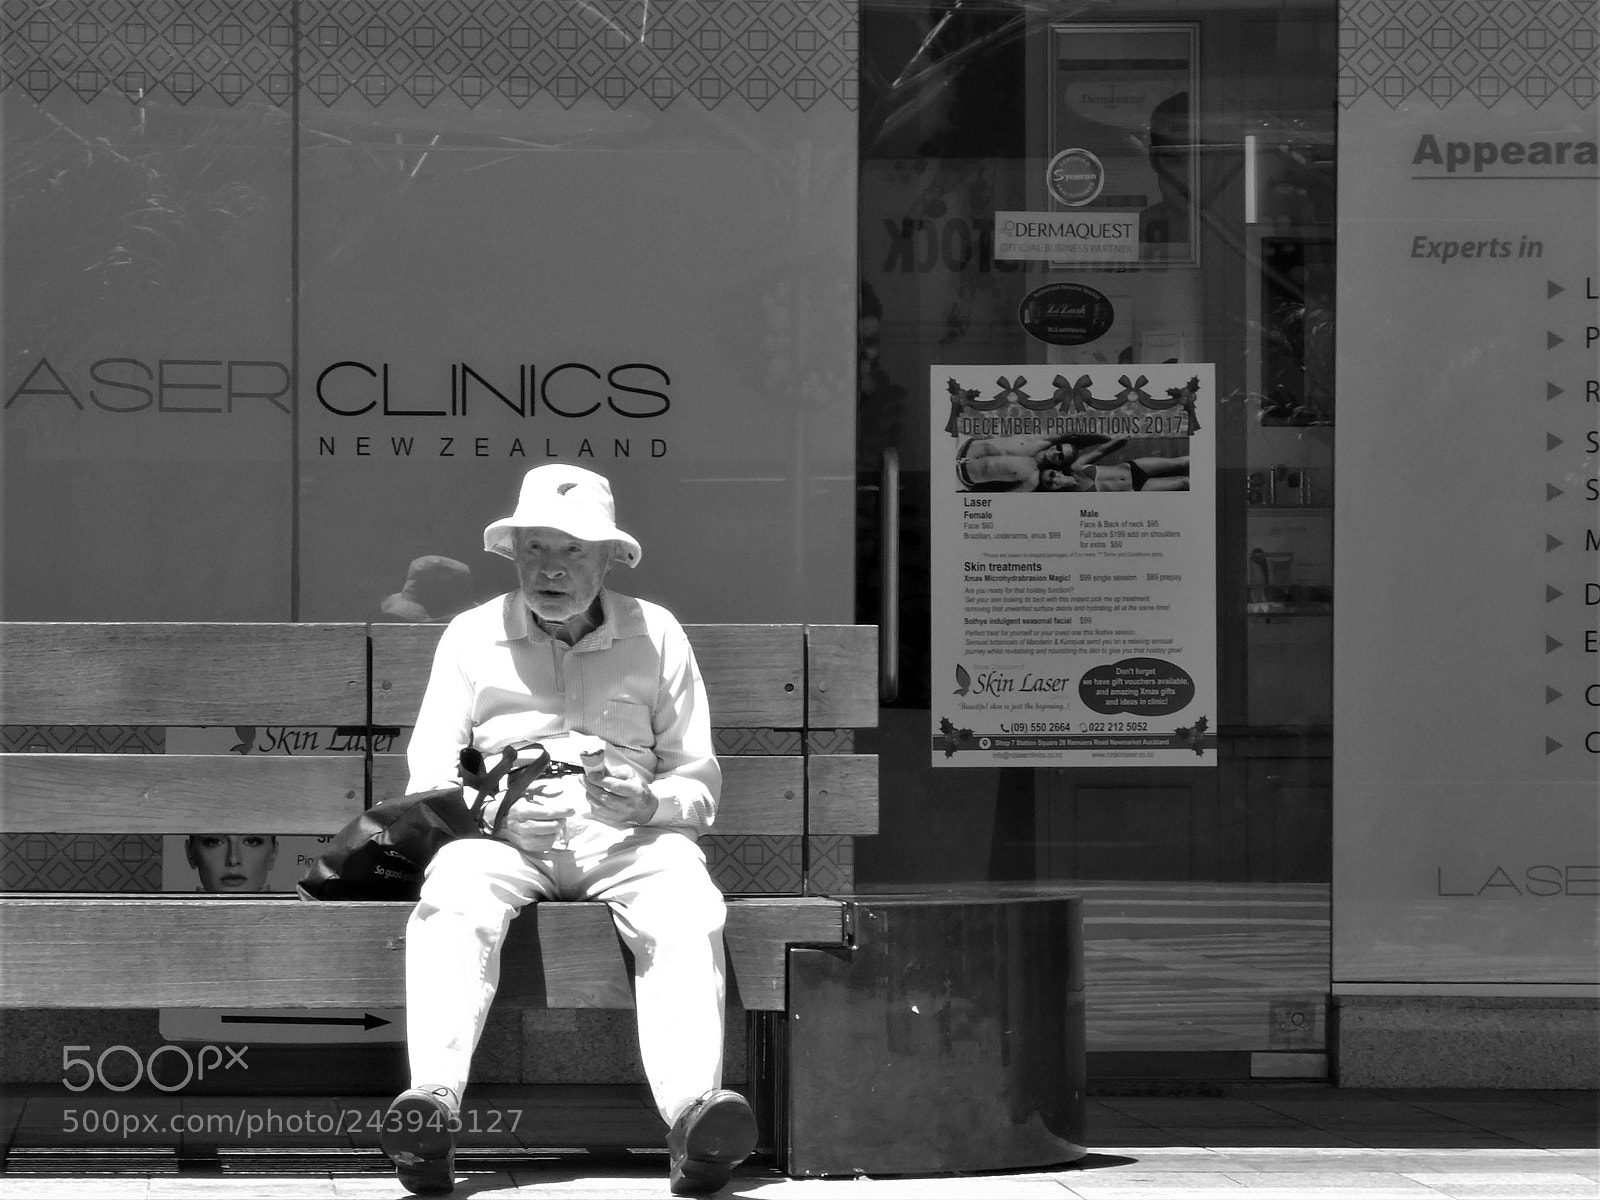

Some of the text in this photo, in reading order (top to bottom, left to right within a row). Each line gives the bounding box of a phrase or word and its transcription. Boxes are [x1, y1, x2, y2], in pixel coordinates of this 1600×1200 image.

[1053, 170, 1097, 182] Syneron
[1015, 223, 1132, 239] DERMAQUEST
[1001, 243, 1133, 253] OFFICIAL BUSINESS PARTNER
[1411, 235, 1543, 264] Experts in
[316, 361, 671, 419] CLINICS
[963, 416, 1182, 435] DECEMBER PROMOTIONS 2017
[963, 497, 992, 507] Laser
[963, 511, 993, 519] Female
[964, 562, 1042, 572] Skin treatments
[964, 574, 983, 582] Xmas
[1048, 574, 1071, 583] Magic!
[964, 618, 987, 626] Sothys
[989, 617, 1020, 626] indulgent
[1022, 617, 1052, 625] seasonal
[1054, 617, 1072, 625] facial
[1135, 668, 1156, 676] forget
[972, 671, 1070, 697] Skin Laser
[1111, 678, 1123, 686] gift
[1110, 688, 1138, 696] amazing
[1160, 688, 1175, 696] gifts
[1011, 722, 1071, 733] (09) 550 2664
[1088, 721, 1148, 732] 022 212 5052
[259, 727, 400, 758] Skin Laer
[374, 865, 384, 875] So
